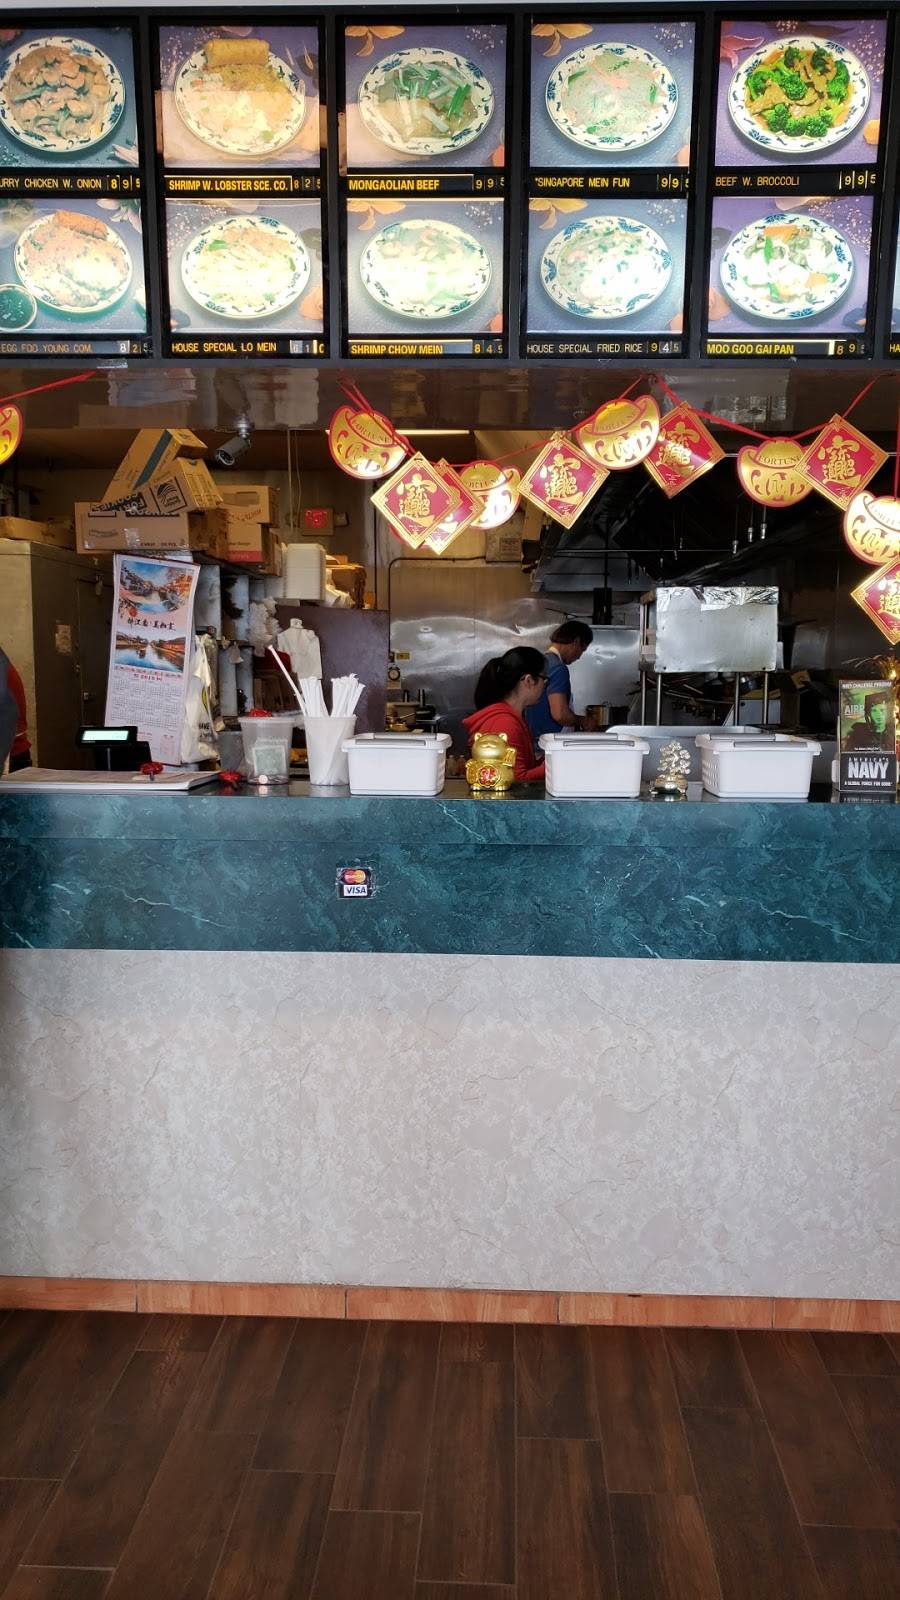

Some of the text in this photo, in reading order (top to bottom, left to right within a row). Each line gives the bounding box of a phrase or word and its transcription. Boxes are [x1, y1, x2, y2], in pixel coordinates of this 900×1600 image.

[24, 178, 59, 188] CHICKEN
[76, 178, 102, 188] ONION
[169, 179, 200, 191] SHRIMP
[202, 180, 213, 191] W.
[214, 179, 251, 191] LOBSTER
[273, 180, 288, 191] CO.
[349, 179, 440, 191] MONGAOLIAN BEEF
[612, 177, 630, 188] FUN
[715, 175, 800, 187] BEEF W. BROCCOLI
[42, 343, 69, 353] YOUNG
[171, 342, 277, 353] HOUSE SPECIAL LO MEIN
[351, 344, 443, 355] SHRIMP CHOW MEIN
[527, 343, 643, 354] HOUSE SPECIAL FRIED RICE
[706, 343, 795, 355] MOO GOO GAI PAN
[848, 761, 889, 779] NAVY
[346, 886, 366, 894] VISA
